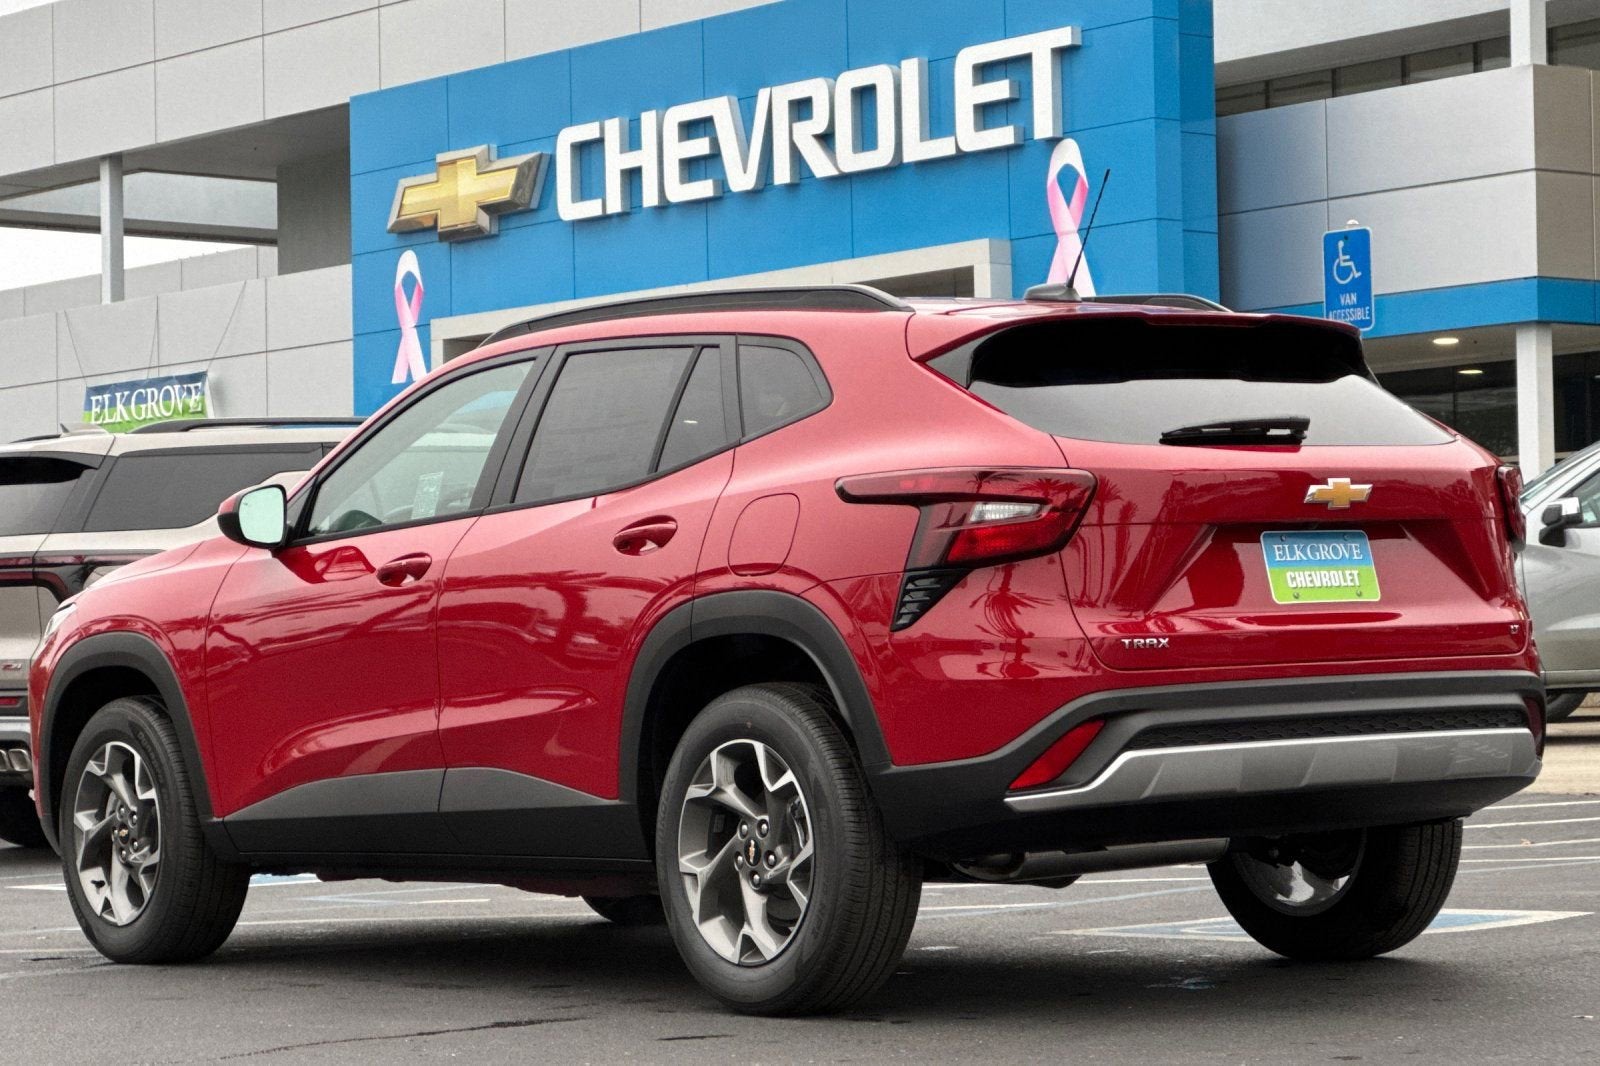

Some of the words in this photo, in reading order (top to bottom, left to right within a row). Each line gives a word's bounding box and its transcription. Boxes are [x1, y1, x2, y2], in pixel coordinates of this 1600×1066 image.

[555, 26, 1081, 222] CHEVROLET
[1339, 293, 1357, 305] VAN
[1328, 306, 1370, 321] ACCESSIBLE
[89, 391, 130, 425] ELK
[130, 382, 202, 420] GROVE
[1272, 543, 1307, 562] ELK
[1306, 543, 1363, 561] GROVE
[1286, 570, 1360, 588] CHEVROLET
[1121, 637, 1170, 649] TRAX
